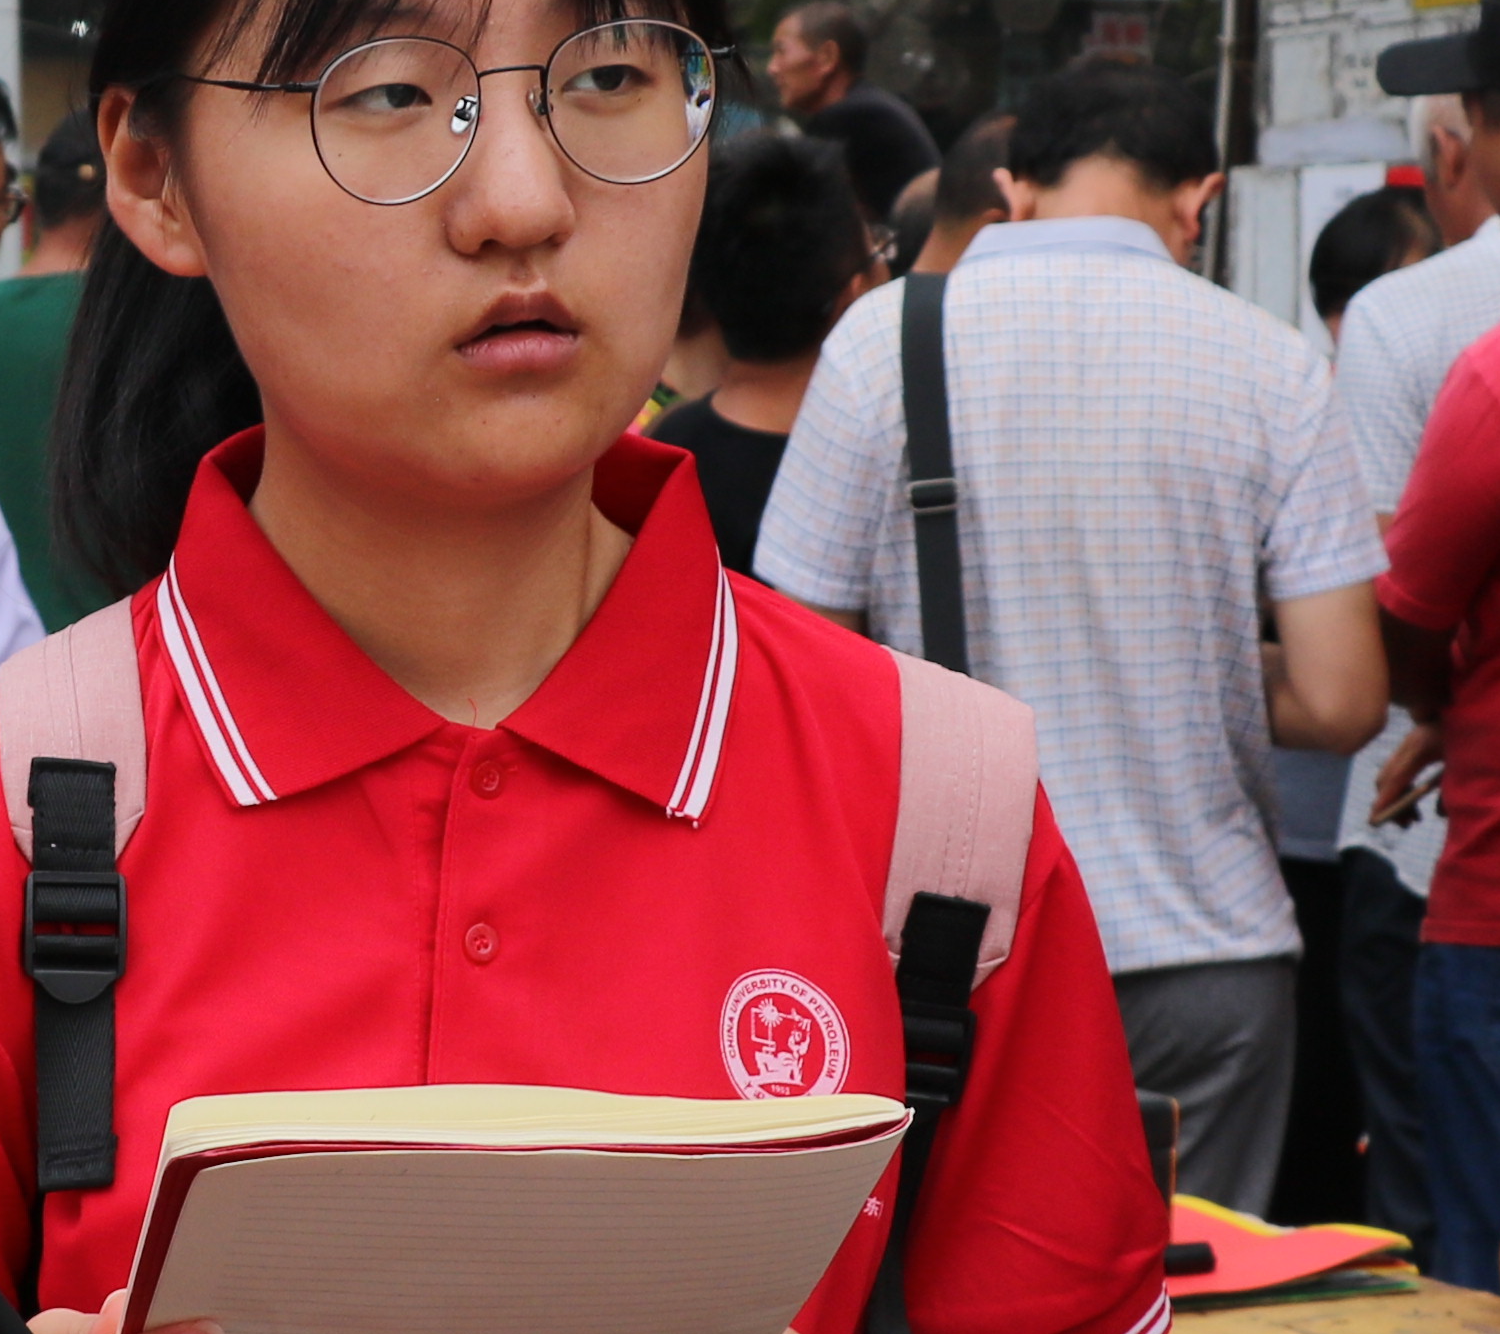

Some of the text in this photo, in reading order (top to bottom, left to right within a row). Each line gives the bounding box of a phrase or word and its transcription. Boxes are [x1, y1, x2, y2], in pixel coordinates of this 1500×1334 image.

[728, 978, 841, 1080] CHINA UNIVERSITY OF PETROLEUM
